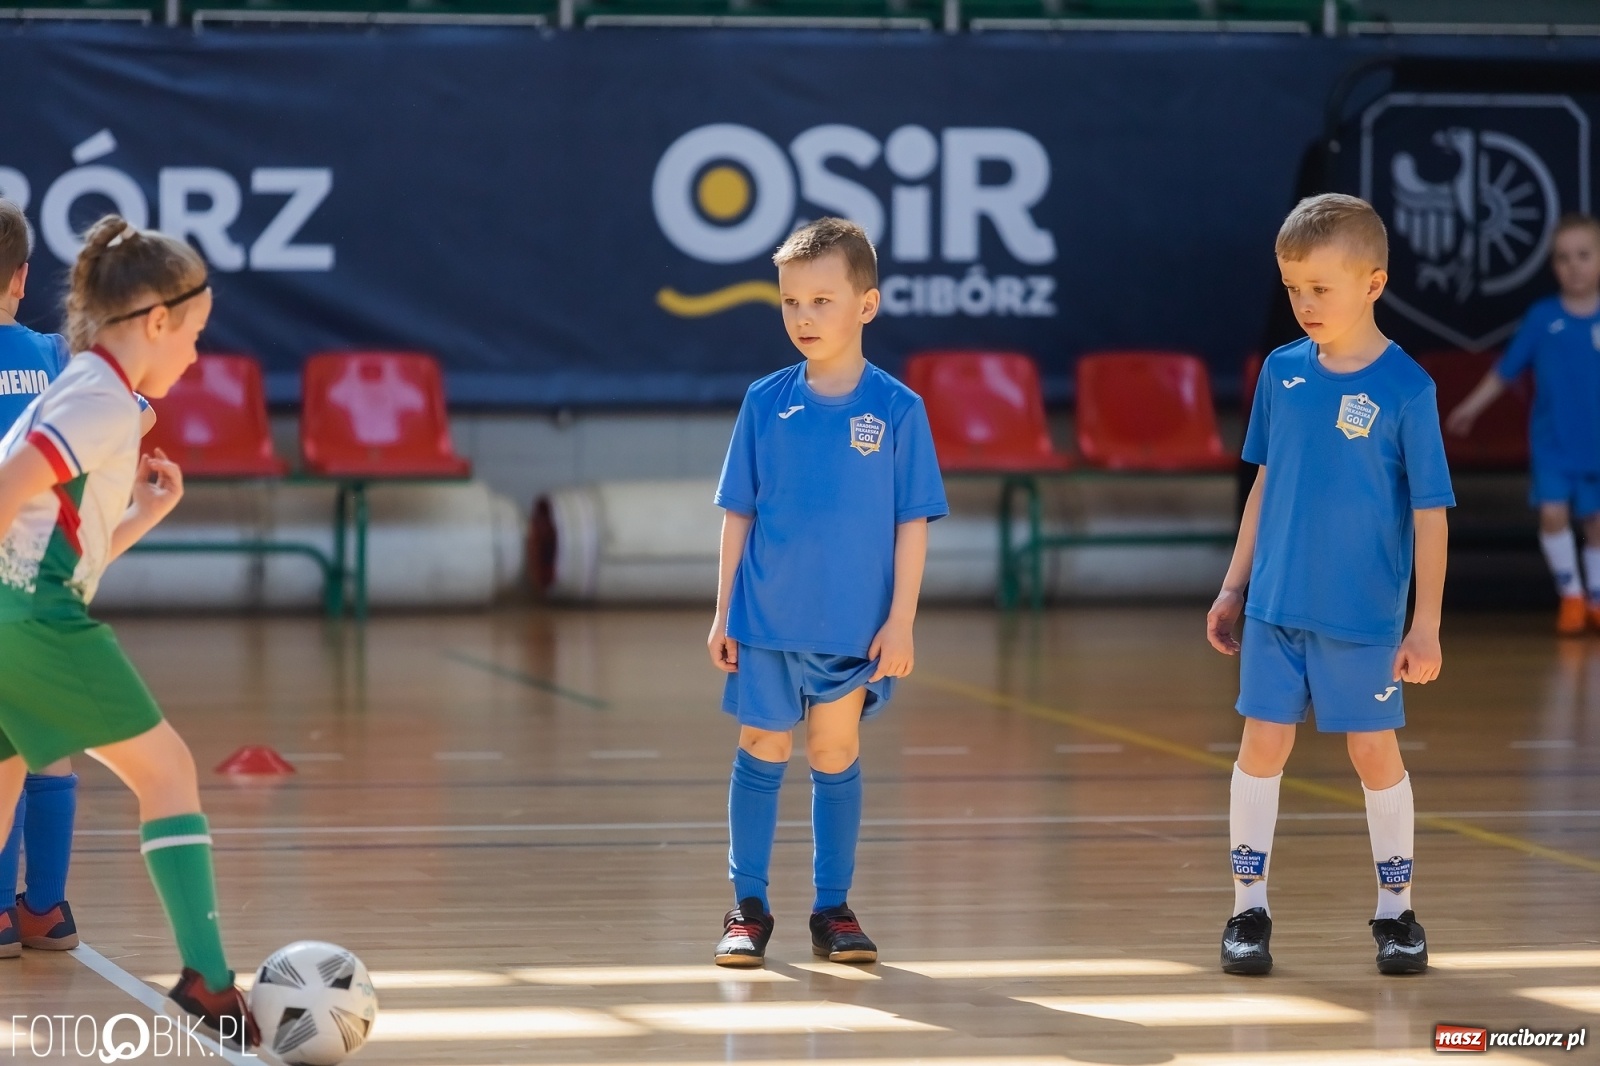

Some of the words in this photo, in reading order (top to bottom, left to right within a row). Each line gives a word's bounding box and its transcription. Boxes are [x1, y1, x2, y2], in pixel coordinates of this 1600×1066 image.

[652, 123, 1058, 265] OSiR
[1346, 414, 1364, 426] GOL
[858, 433, 874, 442] GOL
